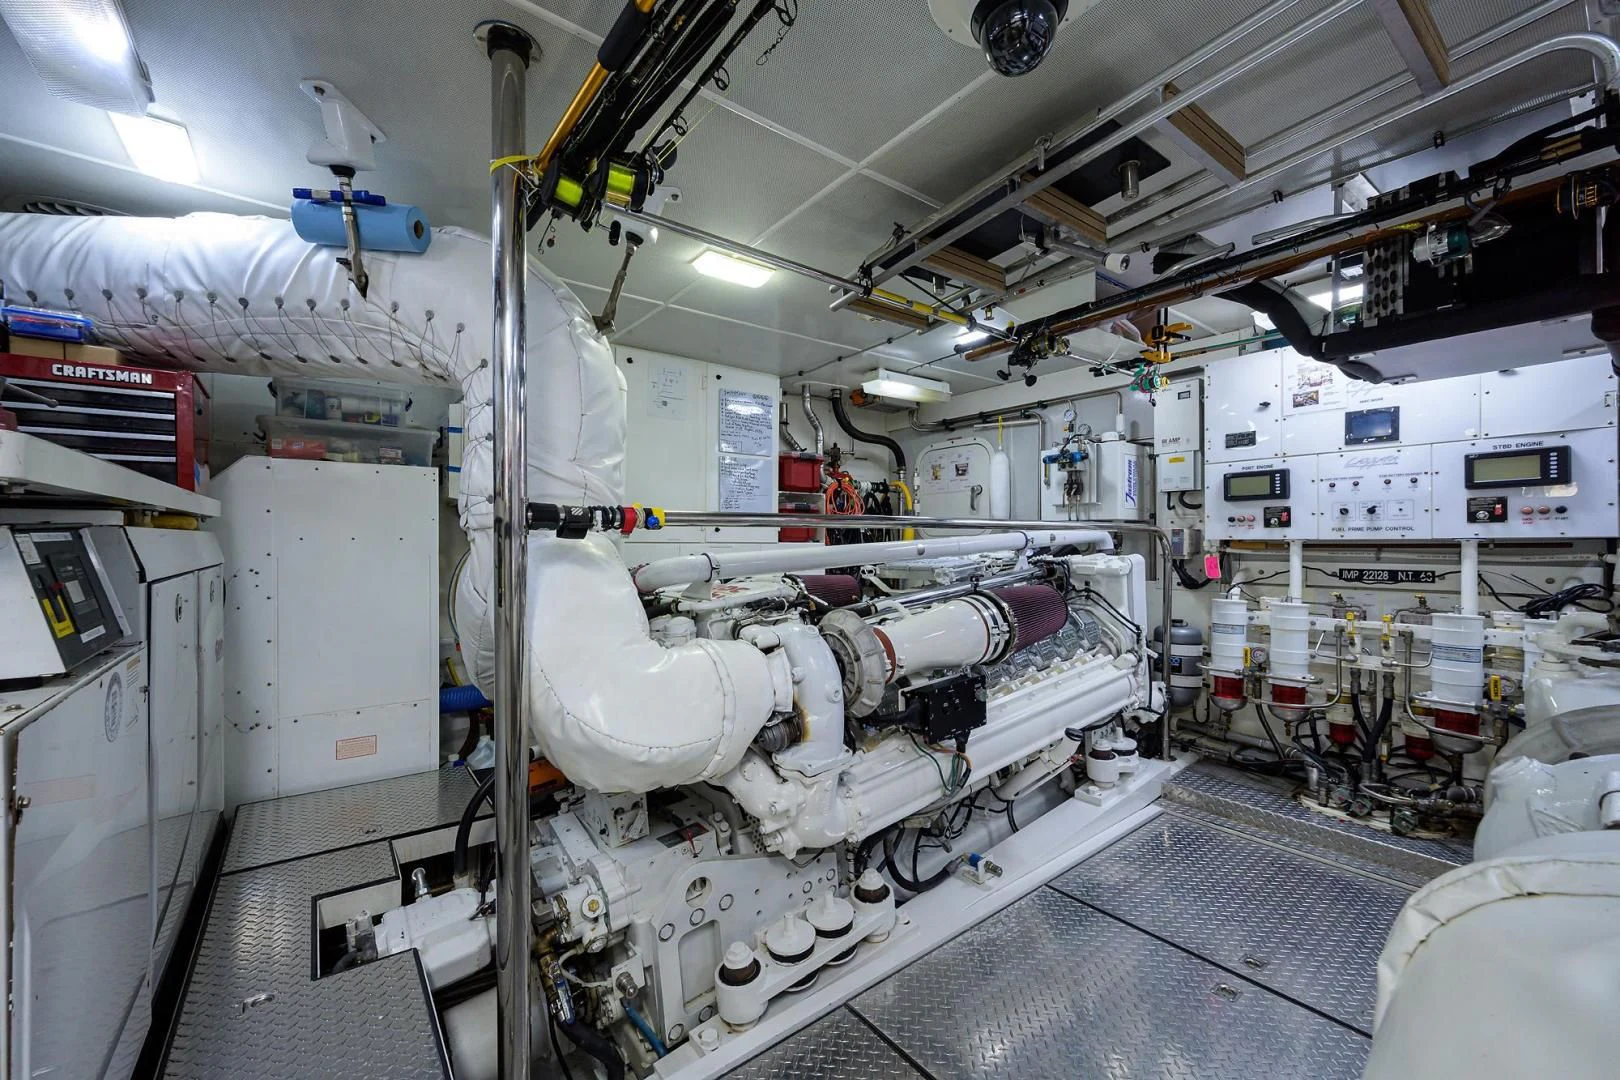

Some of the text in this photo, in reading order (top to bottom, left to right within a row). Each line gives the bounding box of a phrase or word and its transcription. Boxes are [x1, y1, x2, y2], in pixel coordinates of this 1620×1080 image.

[52, 363, 153, 385] CRAFTSMAN
[1515, 440, 1544, 449] ENGINE
[1125, 459, 1136, 507] Jastram
[1342, 570, 1359, 579] IMP
[1362, 570, 1389, 580] 22128
[1397, 571, 1416, 581] N.T.
